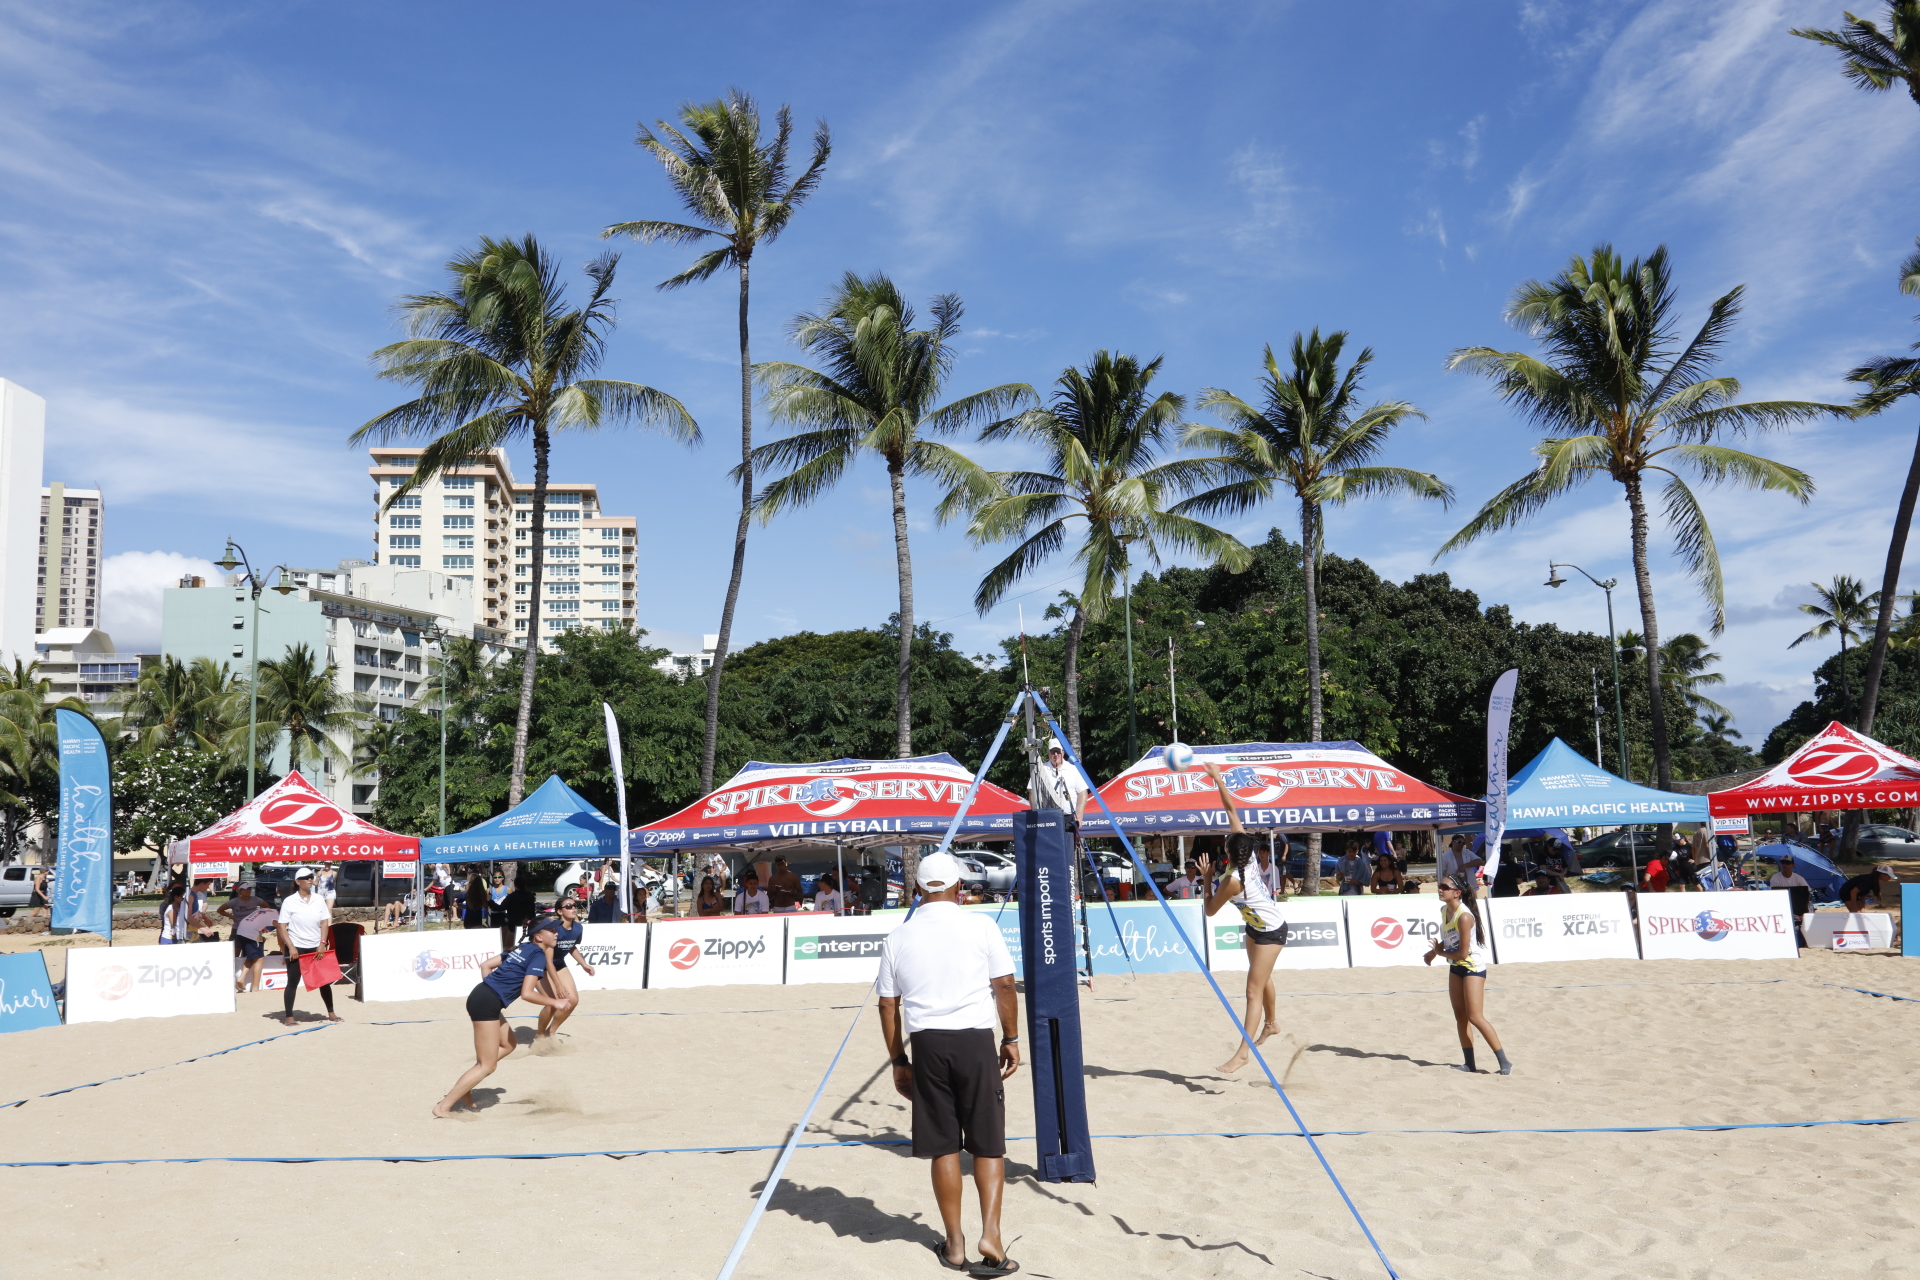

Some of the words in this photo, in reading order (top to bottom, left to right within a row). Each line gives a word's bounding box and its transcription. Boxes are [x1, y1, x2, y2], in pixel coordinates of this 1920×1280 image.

[1125, 772, 1237, 802] SPIKE
[1276, 768, 1405, 792] SERVE
[702, 784, 812, 819] SPIKE
[852, 779, 976, 805] SERVE
[1572, 803, 1626, 815] PACIFIC
[1630, 802, 1685, 813] HEALTH
[1746, 791, 1918, 808] WWW.ZIPPYS.COM
[1082, 818, 1110, 826] erprise
[1200, 807, 1343, 826] VOLEYBALL
[769, 819, 908, 838] VOLLEYBALL
[66, 775, 108, 906] healthier
[436, 844, 489, 854] CREATING
[504, 840, 565, 850] HEALTHIER
[60, 832, 68, 870] HEALTHIER
[228, 845, 384, 857] WWW.ZIPPYS.COM
[1038, 867, 1053, 920] imports
[1183, 888, 1189, 898] 6
[1502, 922, 1543, 939] OC16
[1563, 920, 1619, 936] XCAST
[1648, 915, 1702, 936] SPIKE
[1723, 914, 1786, 934] SERVE
[1041, 921, 1057, 964] sports
[1075, 920, 1198, 962] healthie
[1222, 927, 1336, 944] eprise
[704, 935, 766, 960] Zippy's
[801, 938, 887, 954] enterpri
[576, 951, 634, 966] XCAST
[138, 960, 213, 988] Zippy's
